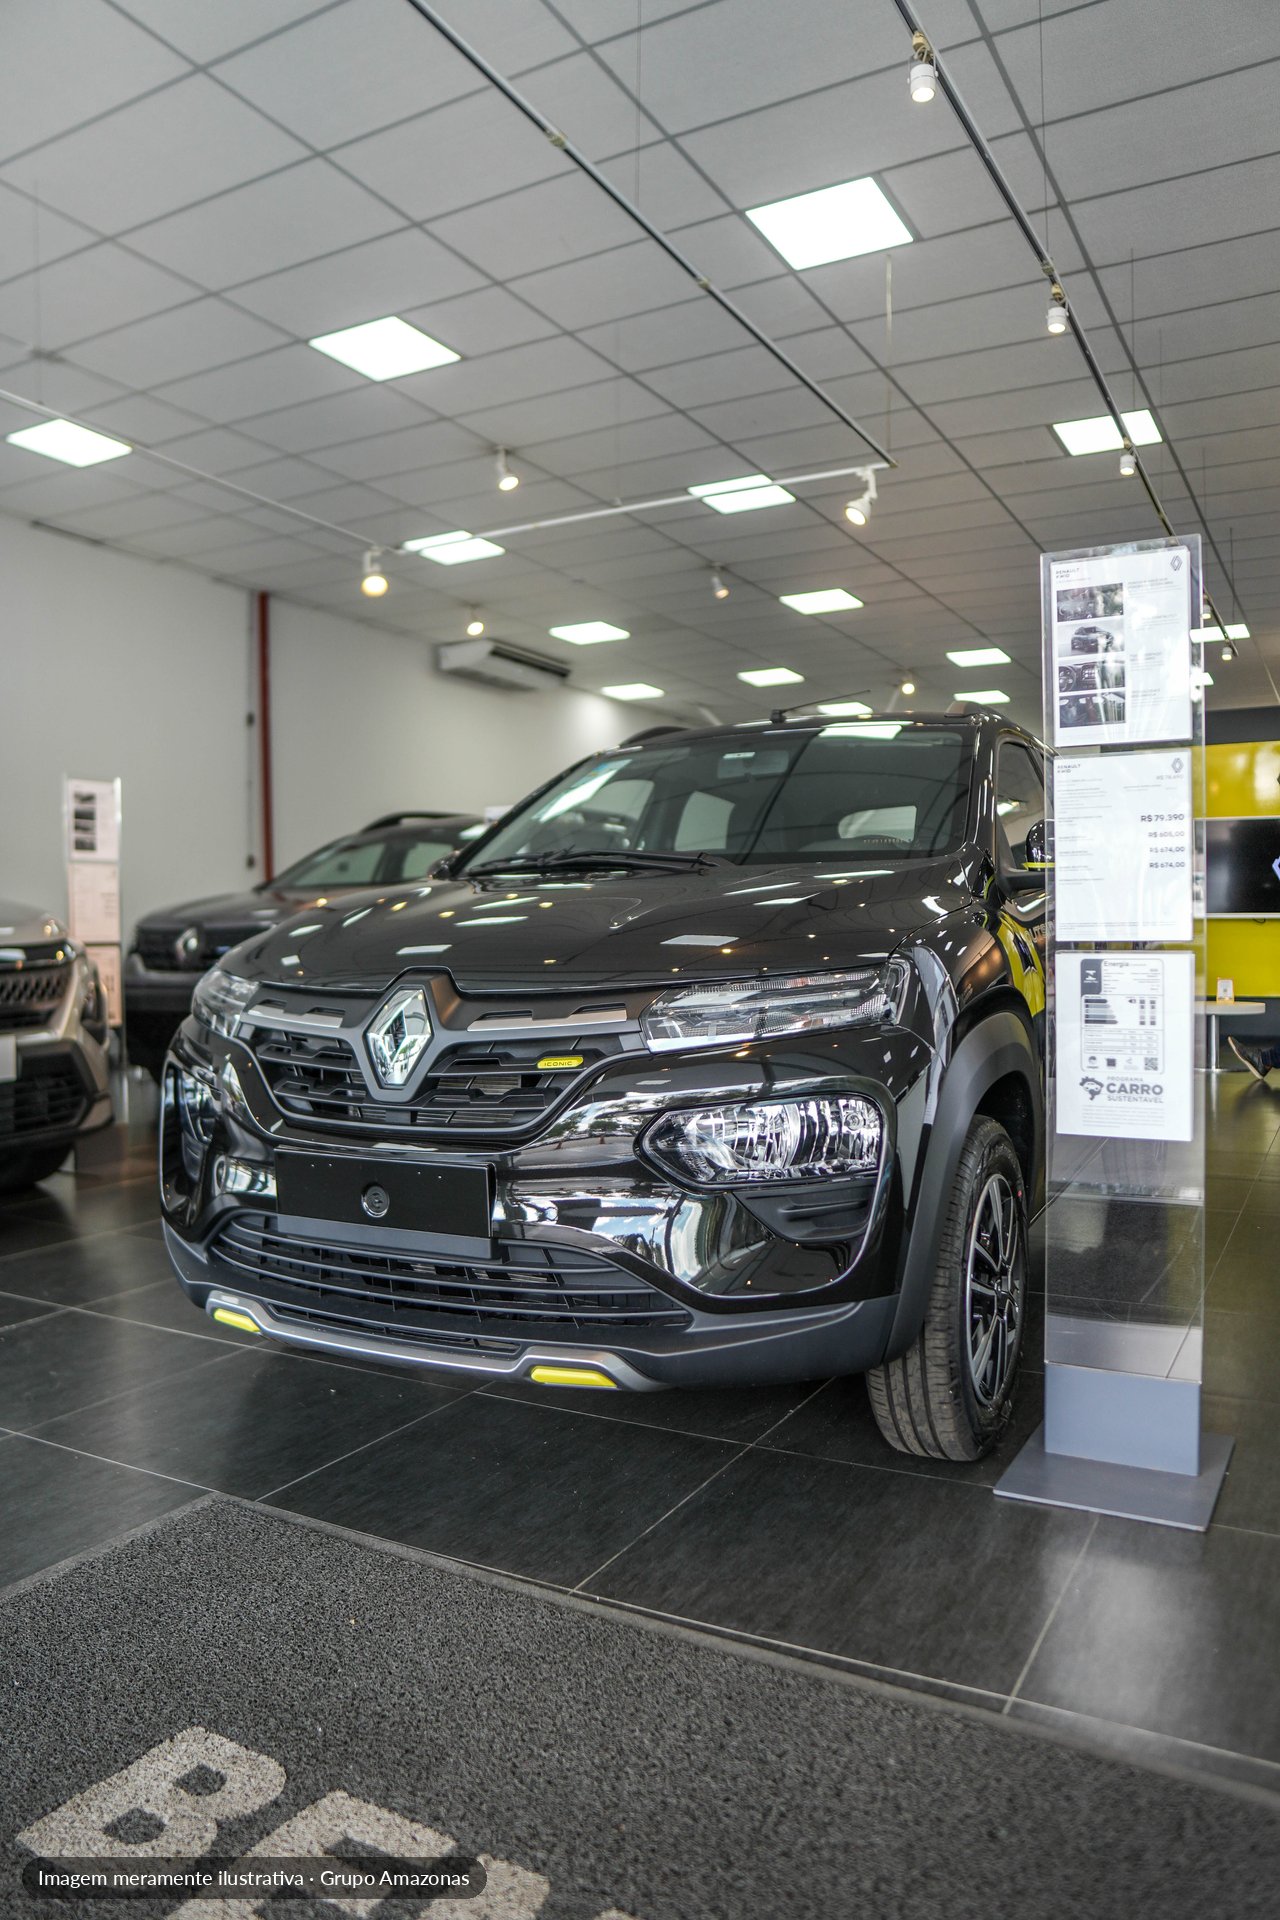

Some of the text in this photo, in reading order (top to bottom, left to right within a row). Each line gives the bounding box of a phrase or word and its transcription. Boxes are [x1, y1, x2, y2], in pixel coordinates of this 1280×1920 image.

[1140, 813, 1185, 823] R$ 79.390
[1103, 960, 1129, 968] Energia
[1106, 1082, 1164, 1096] CARRO
